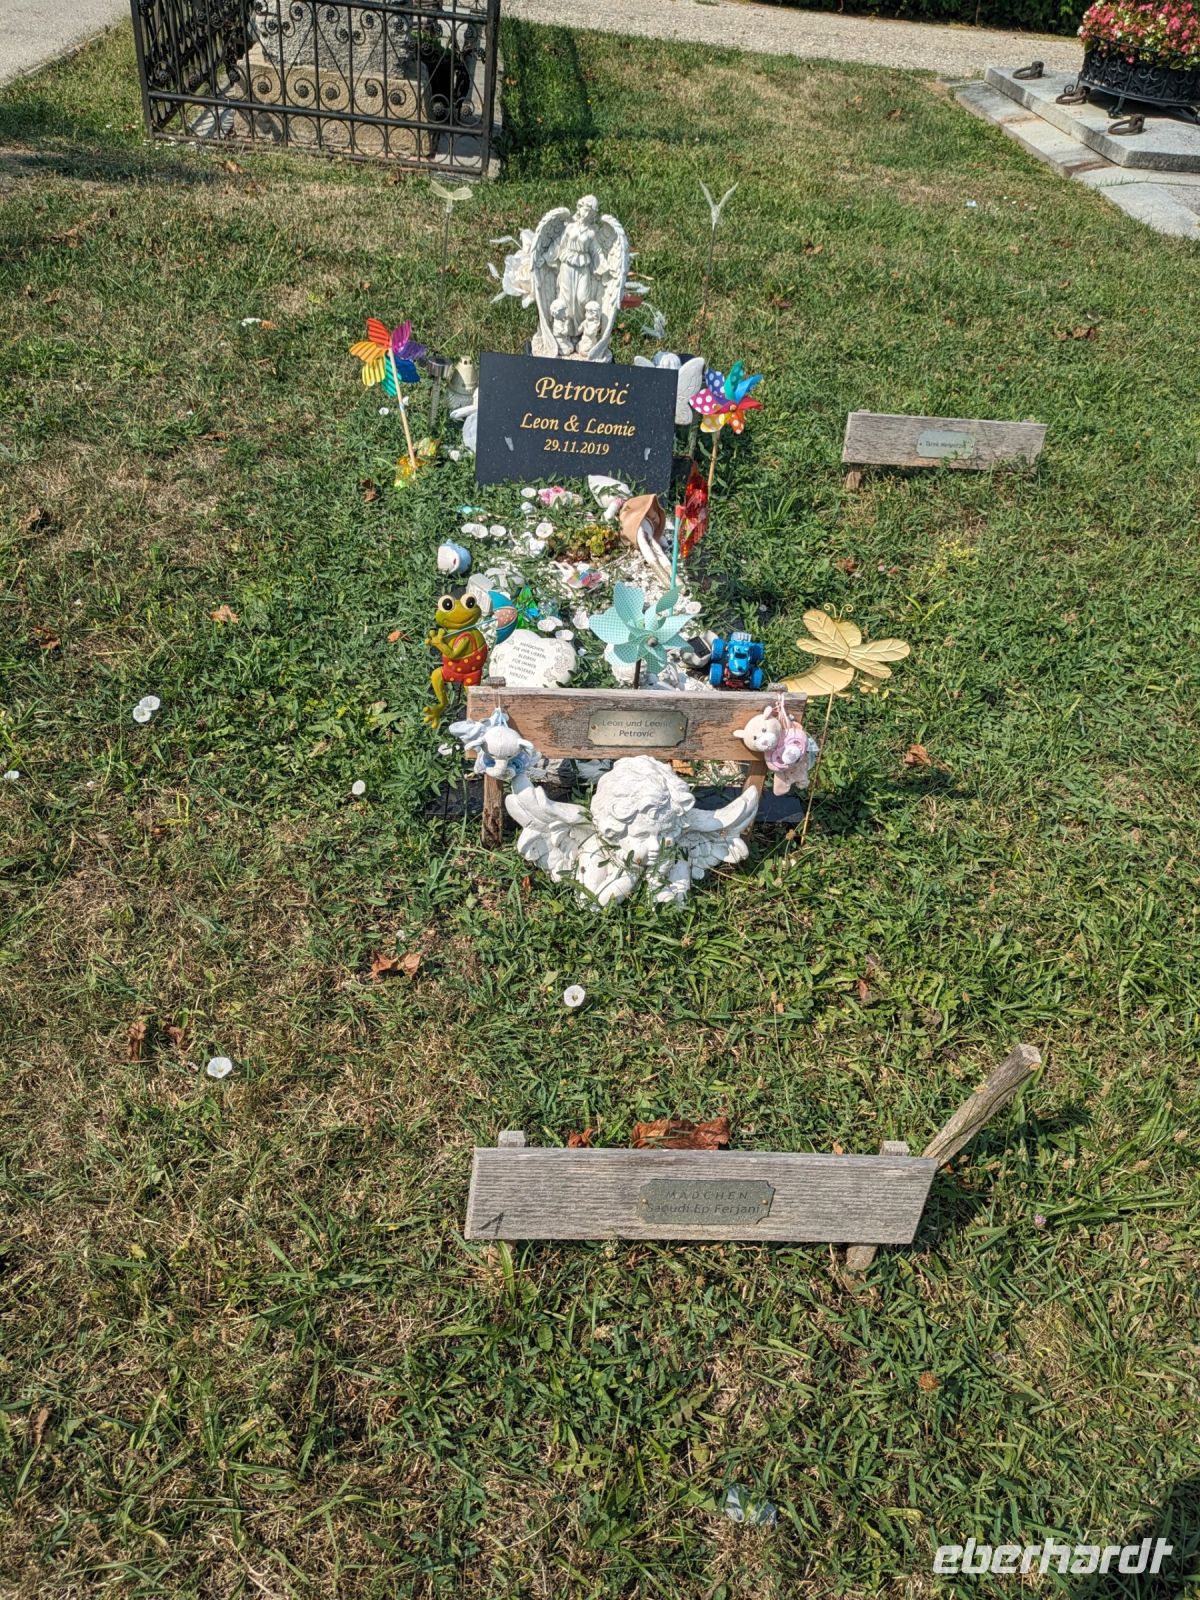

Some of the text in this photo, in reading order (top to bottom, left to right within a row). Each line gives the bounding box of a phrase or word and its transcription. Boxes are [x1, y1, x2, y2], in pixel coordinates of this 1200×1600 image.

[535, 376, 630, 405] Petrović
[520, 412, 636, 437] Leon & Leonie
[543, 438, 610, 455] 29.11.2019
[602, 719, 623, 727] Leon
[626, 719, 642, 727] und
[714, 1204, 760, 1215] Ferjani
